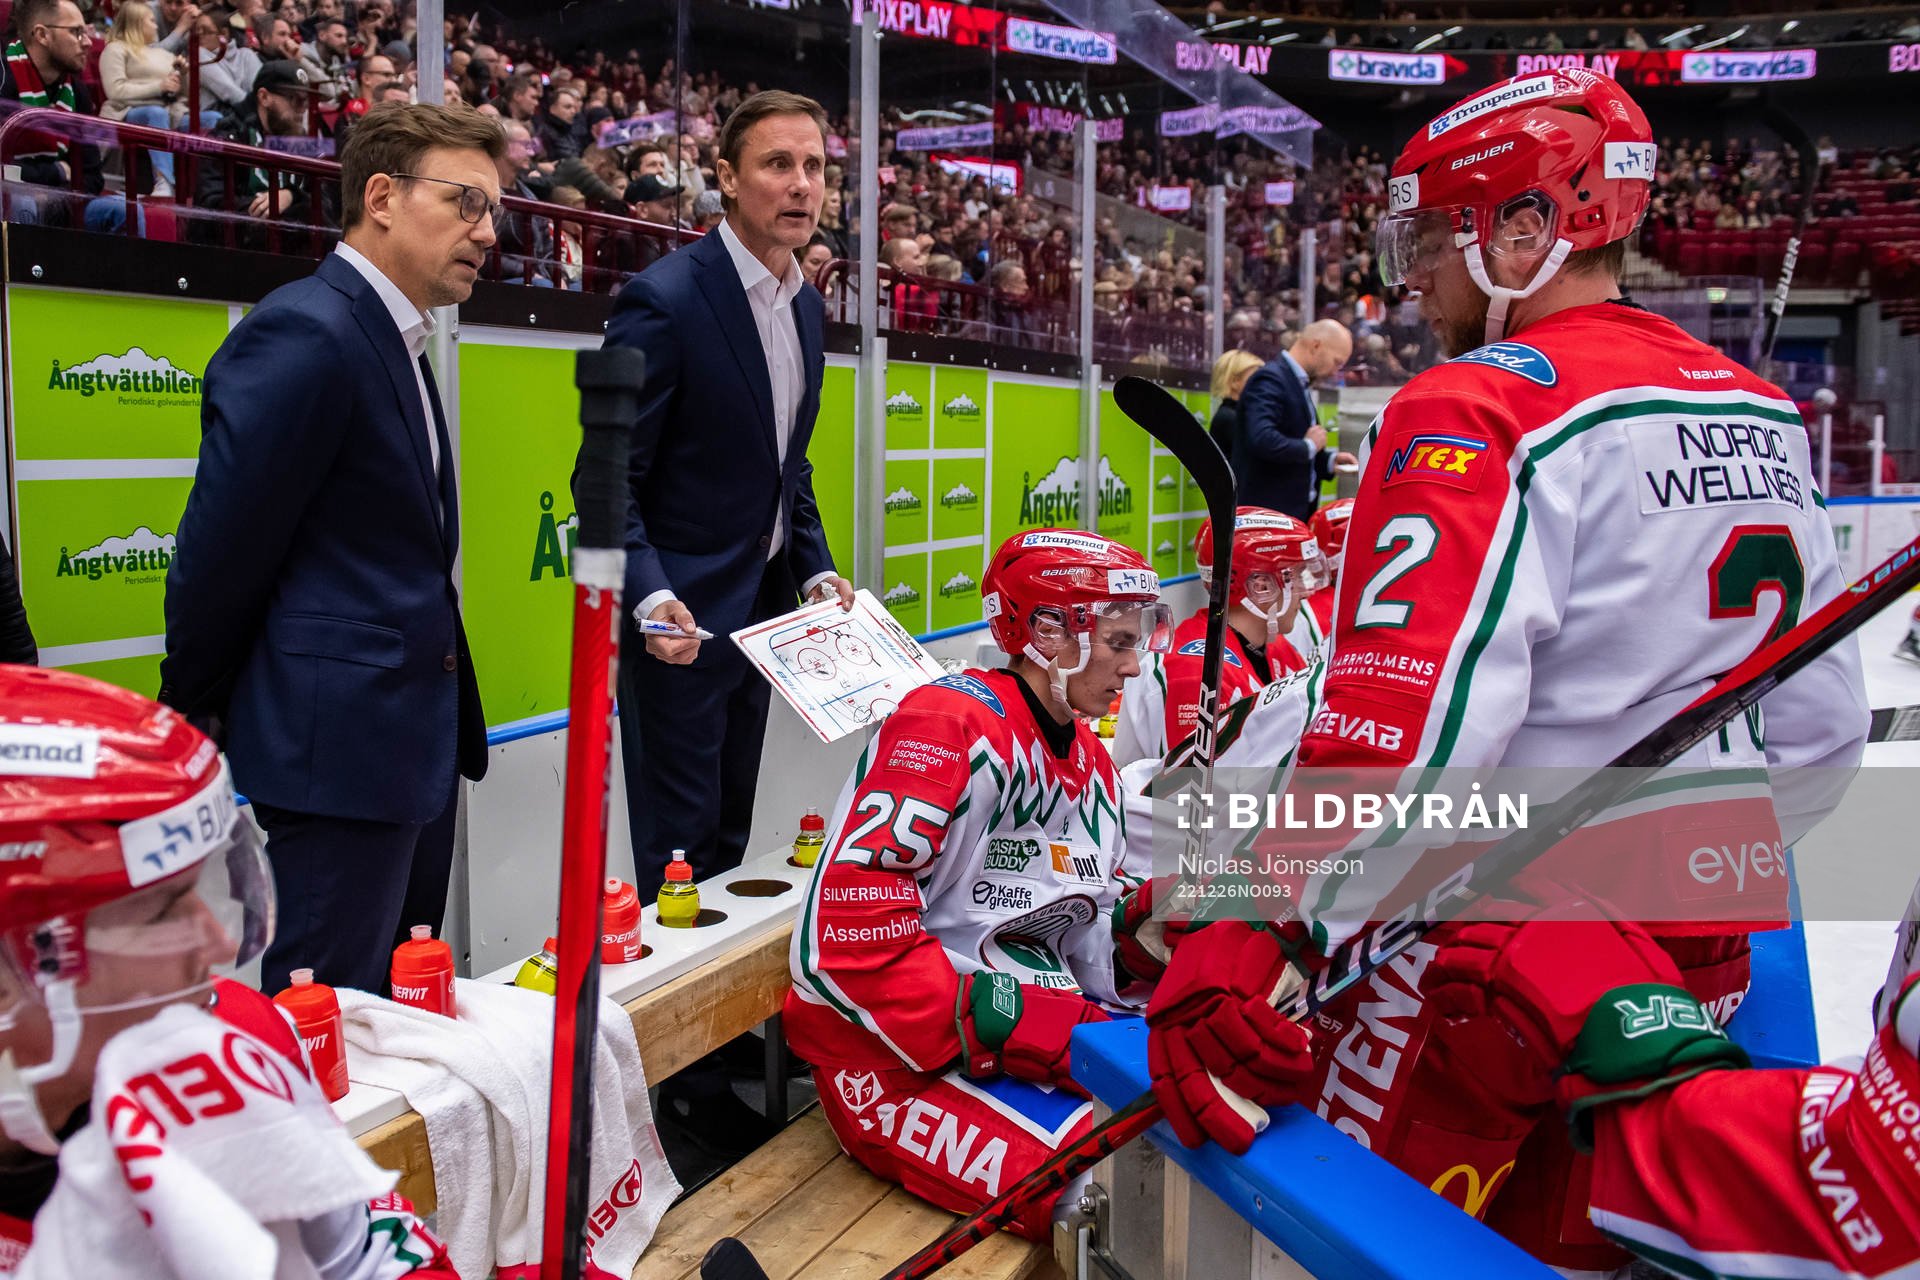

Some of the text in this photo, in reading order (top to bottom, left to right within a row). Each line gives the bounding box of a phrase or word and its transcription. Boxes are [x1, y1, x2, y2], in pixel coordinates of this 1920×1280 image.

[1034, 26, 1109, 58] bravida
[1357, 52, 1437, 79] bravida
[1712, 51, 1807, 78] bravida
[1451, 81, 1548, 122] Tranpenad
[1451, 141, 1516, 170] BAUER
[48, 359, 203, 397] Ångtvättbilen
[1692, 369, 1735, 380] BAUER
[1676, 423, 1788, 463] NORDIC
[1646, 464, 1804, 510] WELLNESS
[1040, 534, 1104, 551] Tranpenad
[56, 547, 177, 581] Ångtvättbi
[1354, 514, 1440, 629] 2
[0, 744, 83, 764] enad
[892, 748, 943, 768] inspection
[896, 739, 961, 762] independent
[888, 757, 927, 772] services
[834, 791, 951, 869] 25
[987, 838, 1021, 856] CASH
[984, 854, 1028, 872] BUDDY
[1688, 840, 1786, 892] eyes
[823, 886, 915, 901] SILVERBULLET
[989, 896, 1032, 910] greven
[998, 885, 1032, 899] Kaffe
[823, 916, 919, 942] Assemblin
